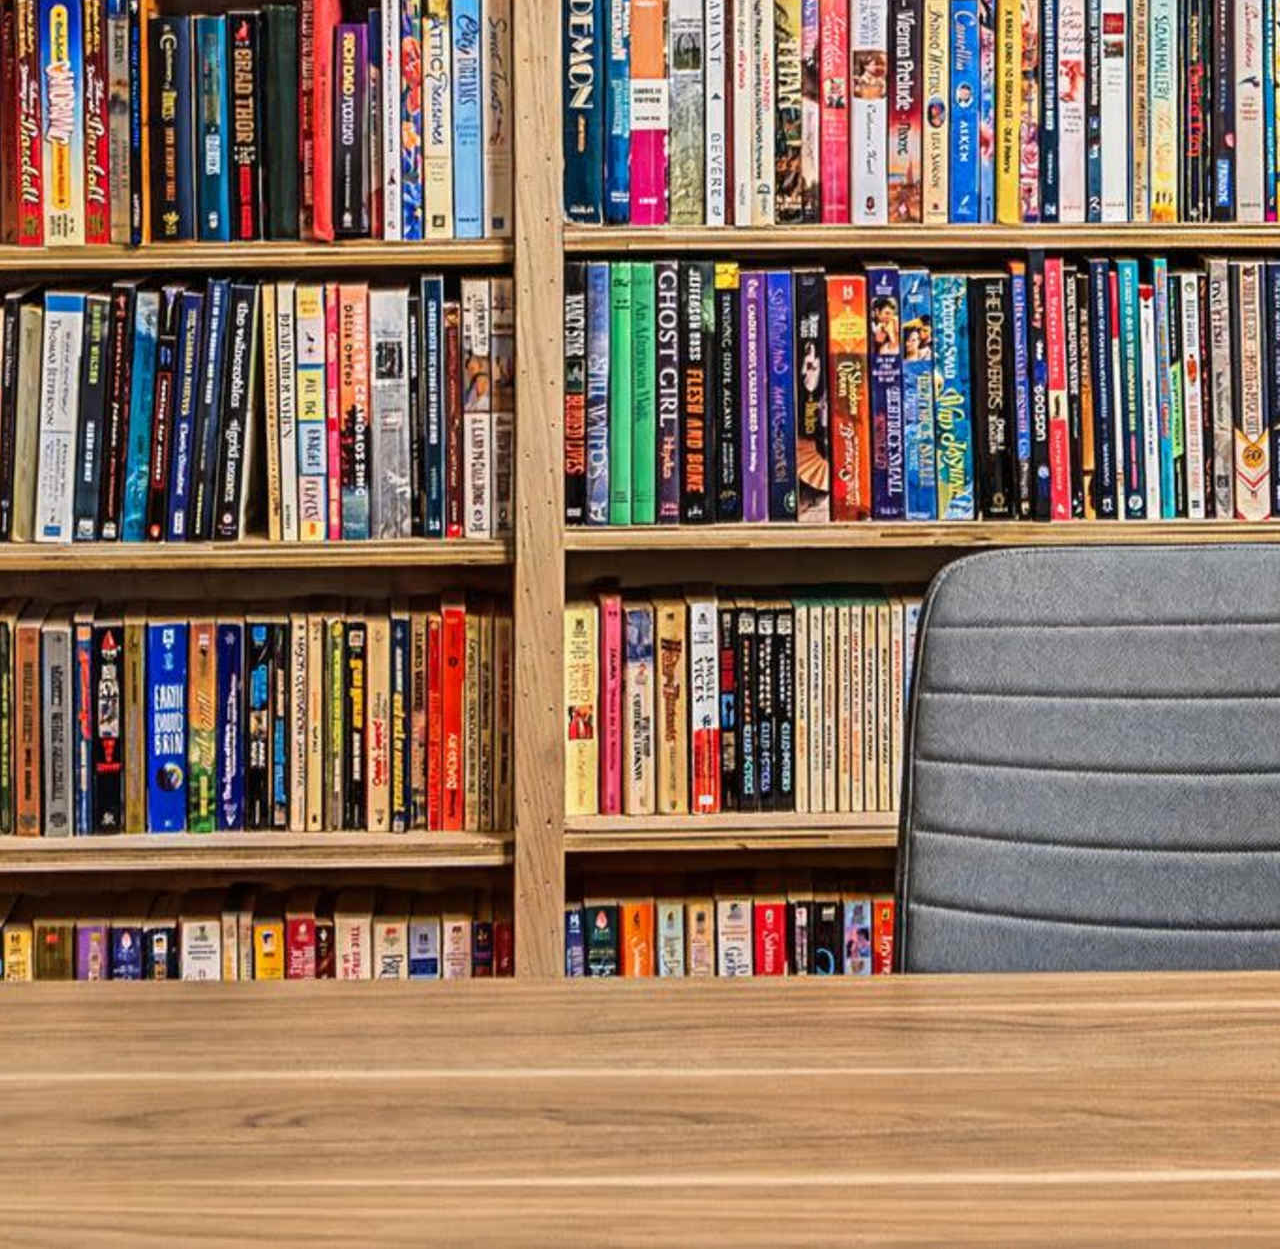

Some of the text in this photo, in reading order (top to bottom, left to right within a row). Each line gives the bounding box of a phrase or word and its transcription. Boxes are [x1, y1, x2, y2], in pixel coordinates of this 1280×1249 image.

[429, 18, 446, 70] ATTIC
[895, 10, 913, 110] Vienna Prelude
[233, 48, 253, 143] BRAD THOR
[658, 271, 677, 363] GHOST
[987, 312, 1003, 409] DISCOVERERS
[659, 367, 677, 428] GIRL
[685, 369, 704, 414] FLESH
[686, 417, 704, 448] AND
[686, 453, 704, 493] BONE
